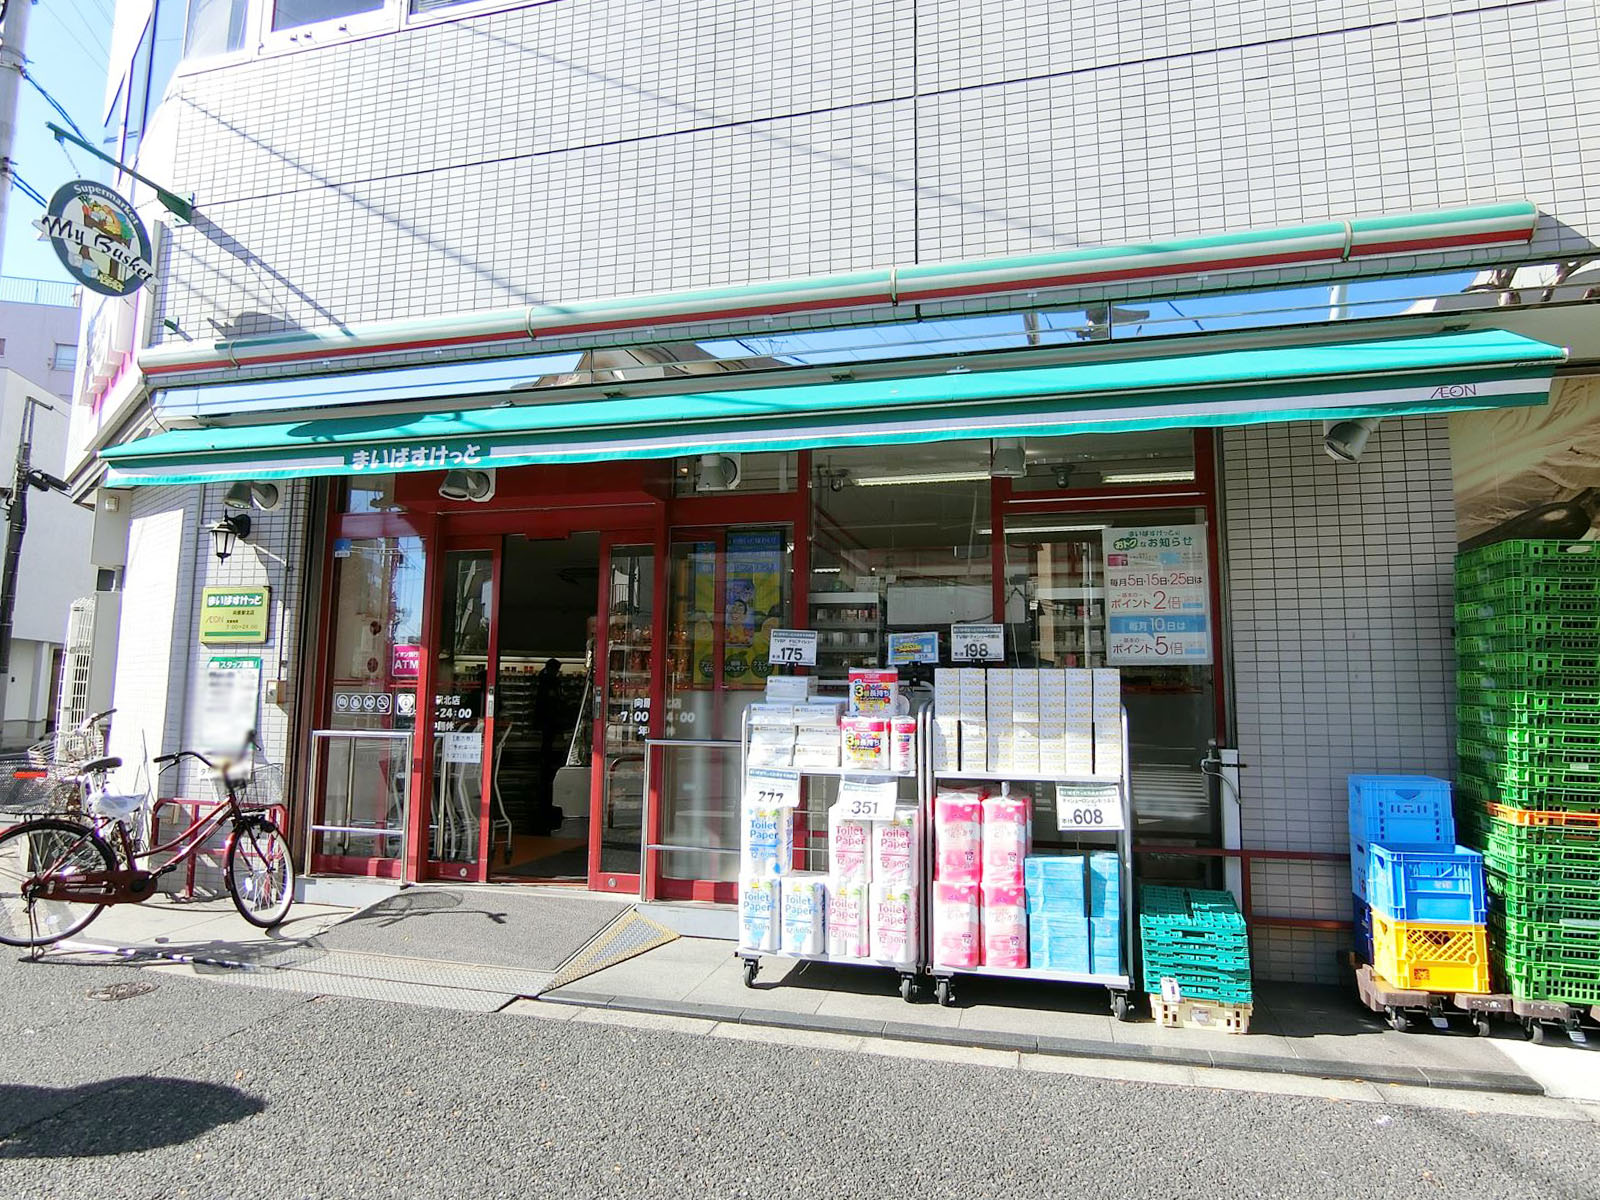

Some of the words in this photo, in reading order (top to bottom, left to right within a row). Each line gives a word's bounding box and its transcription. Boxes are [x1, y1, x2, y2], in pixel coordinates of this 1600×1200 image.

[74, 184, 140, 224] Supermarket
[41, 216, 85, 246] My
[94, 234, 154, 280] Basket
[352, 444, 481, 470] まいばすけっと
[208, 596, 262, 606] まいばすけっと
[1111, 590, 1182, 610] ポイント2倍
[964, 643, 988, 657] 198
[1112, 636, 1183, 655] ポイント5倍
[781, 648, 803, 660] 175
[395, 660, 418, 669] ATM
[620, 711, 649, 722] 7:00
[851, 800, 878, 814] 351
[1074, 808, 1103, 824] 608
[750, 819, 777, 829] Toilet
[750, 830, 779, 840] Paper
[836, 825, 864, 836] Toilet
[882, 829, 909, 839] Toilet
[836, 836, 865, 846] Paper
[881, 838, 910, 849] Paper
[744, 892, 769, 902] Toilet
[786, 894, 810, 905] Toilet
[744, 902, 771, 912] Paper
[786, 905, 813, 916] Paper
[830, 900, 857, 910] Toilet
[879, 903, 906, 914] Toilet
[830, 909, 859, 920] Paper
[878, 914, 908, 925] Paper
